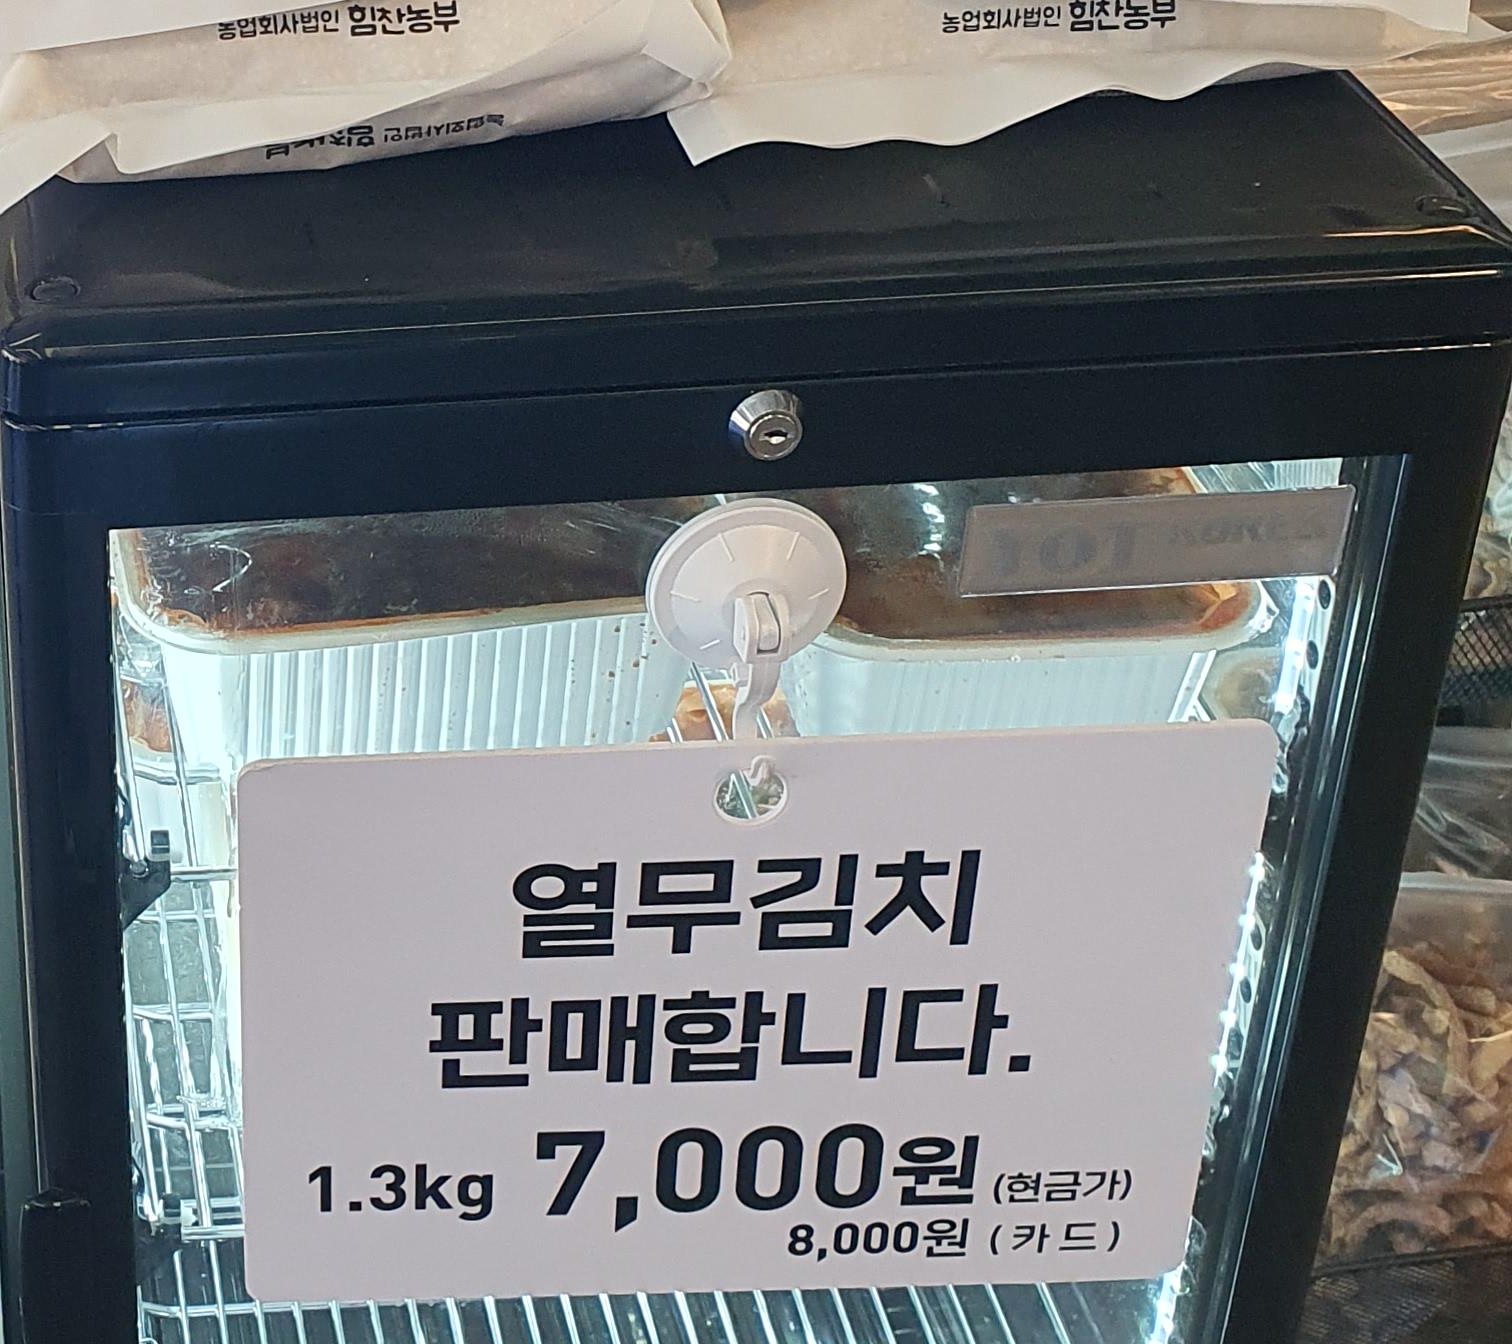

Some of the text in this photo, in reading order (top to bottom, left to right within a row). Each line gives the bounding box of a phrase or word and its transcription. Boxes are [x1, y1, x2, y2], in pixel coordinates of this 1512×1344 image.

[217, 0, 461, 41] 농업회사법인 힘찬농부
[942, 5, 1062, 34] 농업회사법인
[511, 848, 982, 960] 열무김치
[428, 982, 1033, 1089] 판매합니다.
[306, 1163, 495, 1221] 1.3kg
[786, 1216, 969, 1263] 8,000원
